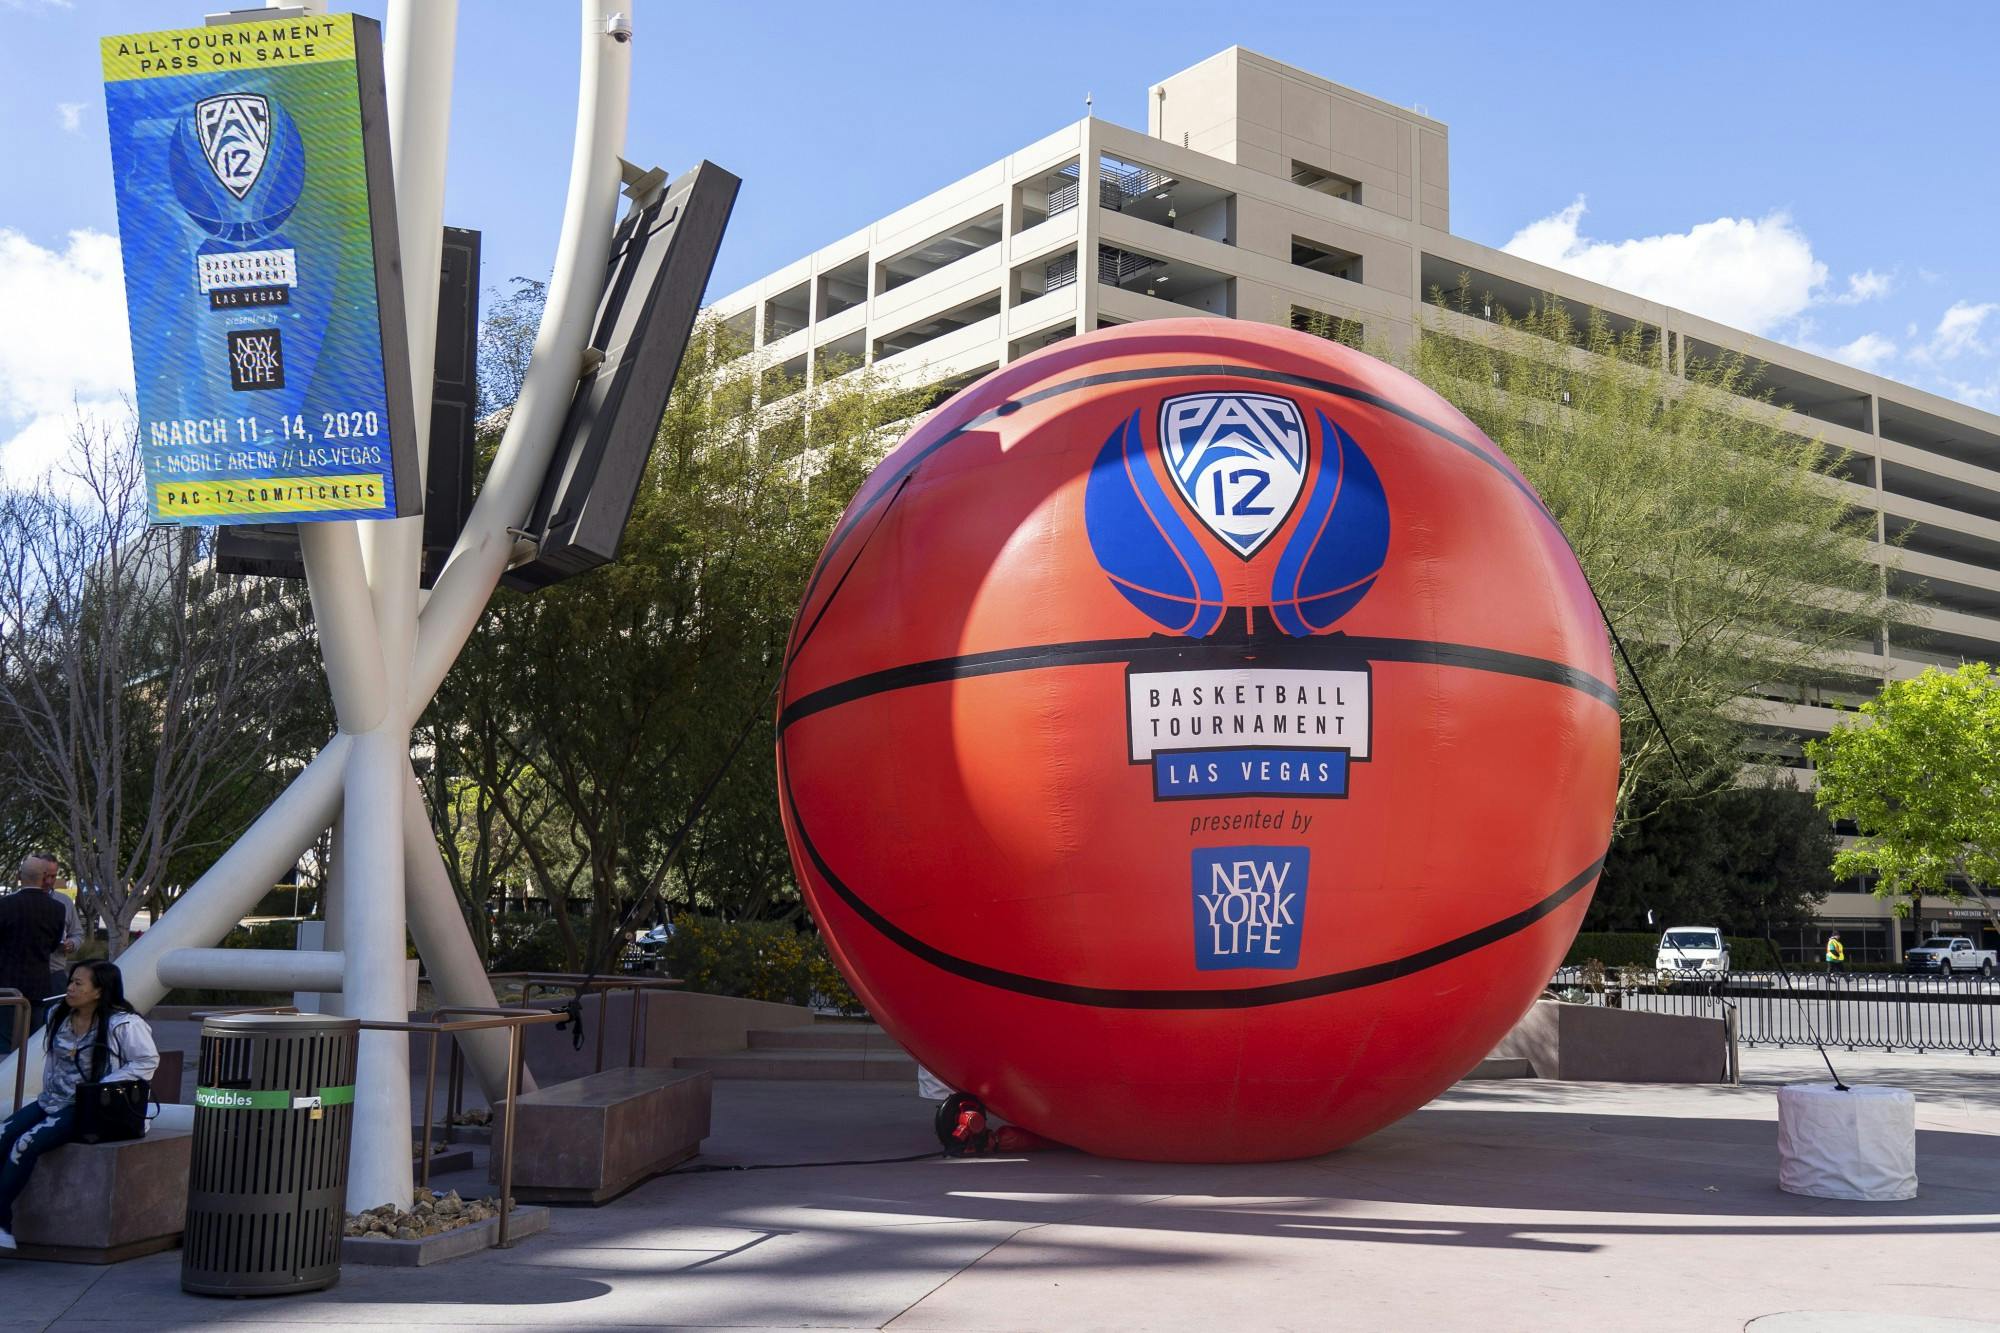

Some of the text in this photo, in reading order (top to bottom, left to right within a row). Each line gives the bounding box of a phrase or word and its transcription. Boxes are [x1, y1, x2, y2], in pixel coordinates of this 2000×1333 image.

[118, 23, 336, 56] ALL-TOURNAMENT
[141, 44, 315, 73] PASS ON SALE
[200, 99, 267, 158] PAC
[224, 149, 252, 178] 12
[206, 257, 286, 271] BASKETBALL
[207, 270, 286, 284] TOURNAMENT
[216, 291, 282, 304] LAS VEGAS
[236, 336, 273, 354] NEW
[232, 350, 279, 368] YORK
[240, 367, 276, 383] LIFE
[150, 418, 228, 446] MARCH
[236, 416, 258, 442] 11
[281, 414, 313, 444] 14,
[322, 411, 379, 438] 2020
[1167, 397, 1300, 483] PAC
[153, 453, 224, 473] T-MOBILE
[228, 451, 278, 470] ARENA
[299, 448, 327, 467] LAS
[330, 446, 381, 466] VEGAS
[168, 484, 375, 505] PAC-12.COM/TICKETS
[1213, 468, 1275, 516] 12
[1150, 685, 1345, 708] BASKETBALL
[1150, 714, 1345, 737] TOURNAMENT
[1170, 761, 1329, 784] LAS VEGAS
[1190, 809, 1313, 836] presented by
[1211, 860, 1292, 896] NEW
[1197, 892, 1297, 927] YORK
[1212, 921, 1283, 956] LIFE
